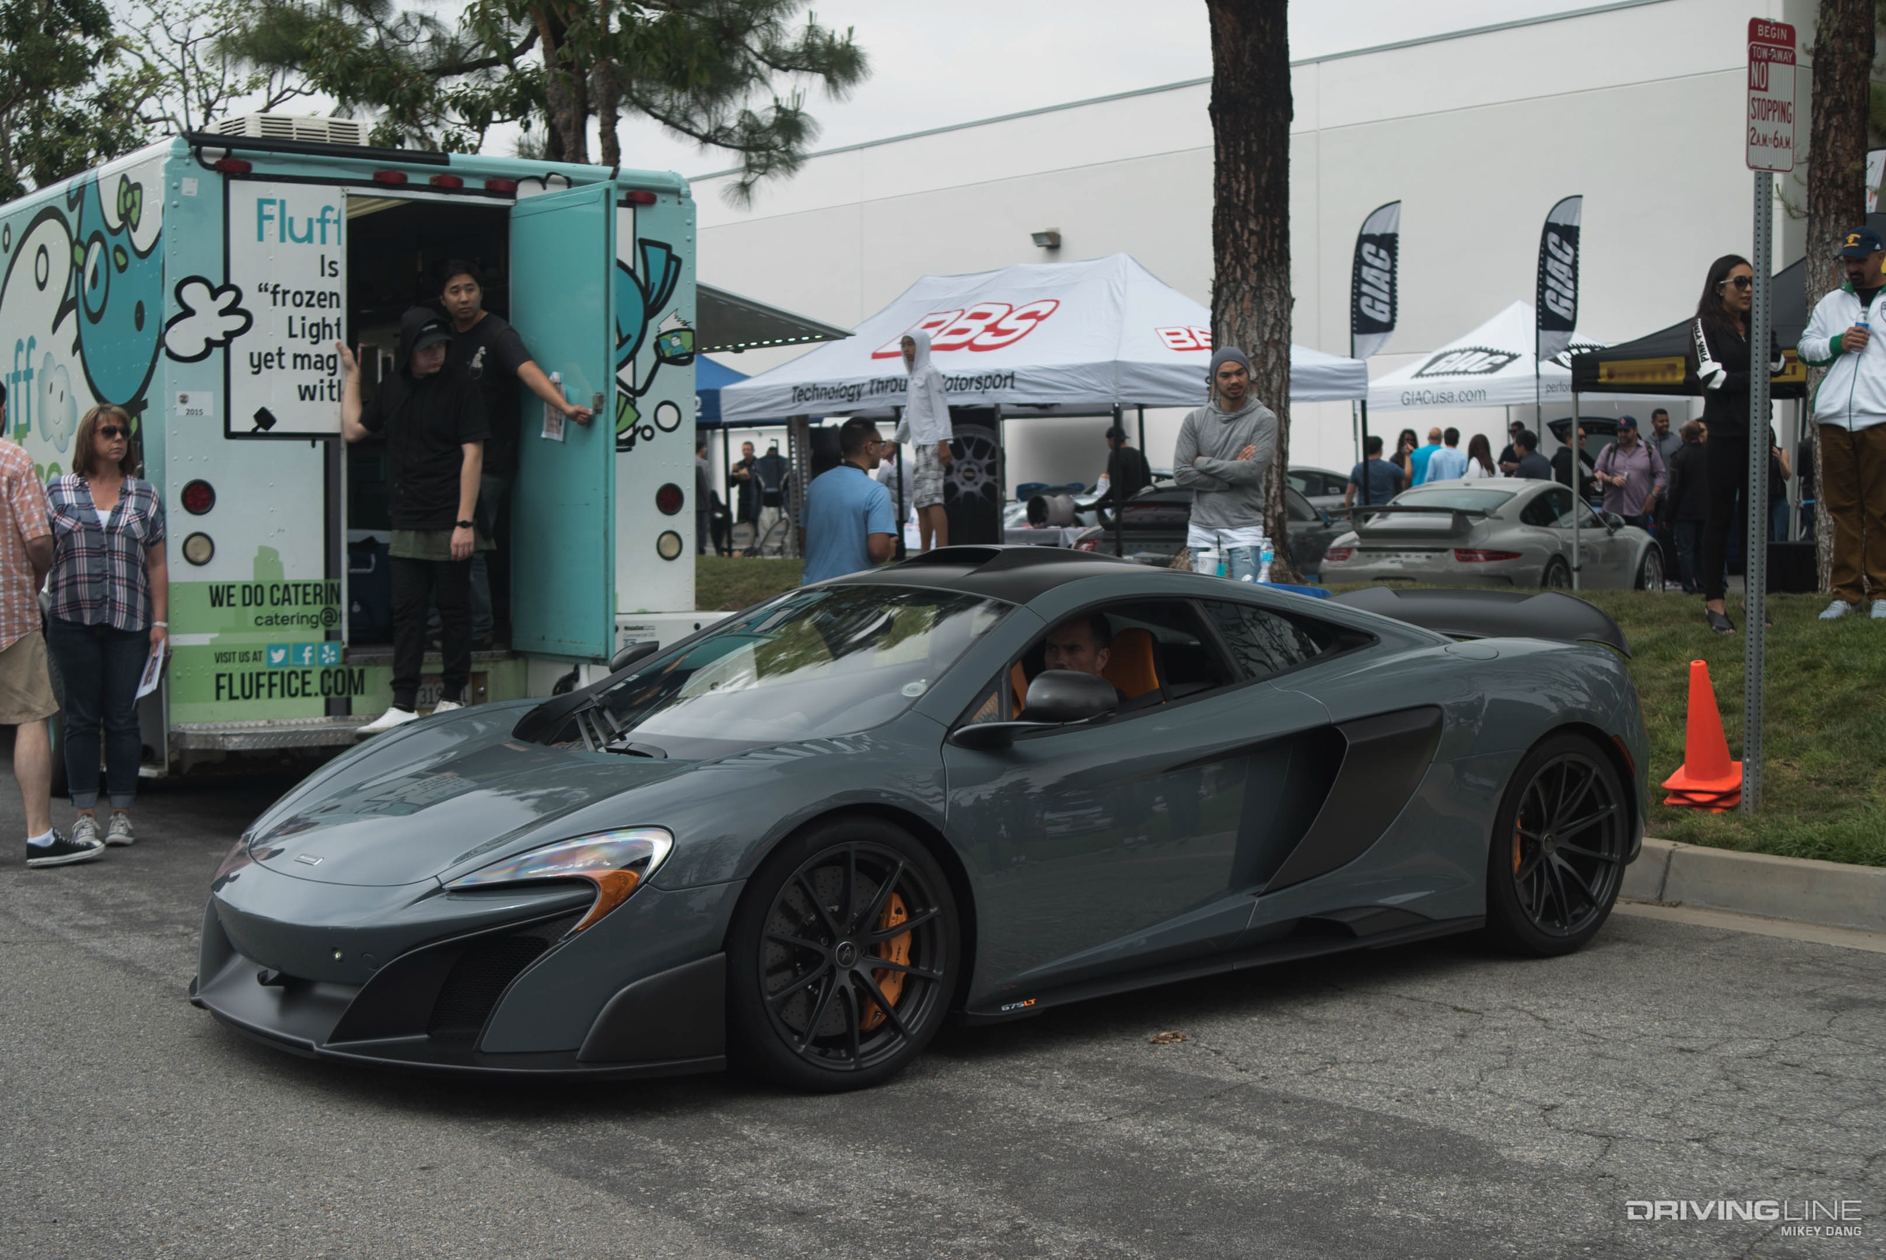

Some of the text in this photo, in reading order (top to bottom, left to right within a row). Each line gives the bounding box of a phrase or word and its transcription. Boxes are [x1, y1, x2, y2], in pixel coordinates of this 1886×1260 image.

[1757, 24, 1787, 40] BEGIN
[1752, 46, 1793, 63] TOW-AWAY
[1751, 61, 1767, 88] NO
[1751, 97, 1792, 124] STOPPING
[320, 254, 339, 278] Is
[1545, 231, 1575, 321] GIAC
[1360, 242, 1391, 323] GIAC
[288, 315, 341, 345] Light
[871, 299, 1060, 359] BBS
[249, 346, 337, 376] yet mag
[1420, 350, 1510, 374] GIAC
[792, 371, 1015, 402] Technology Throu otorsport
[1401, 388, 1487, 406] GIACusa.com
[186, 408, 204, 416] 2015
[209, 582, 341, 608] WE DO CATERIN
[254, 607, 341, 629] catering@
[215, 651, 237, 664] VISIT
[239, 651, 250, 663] US
[252, 650, 263, 663] AT
[215, 668, 365, 701] FLUFFICE.COM
